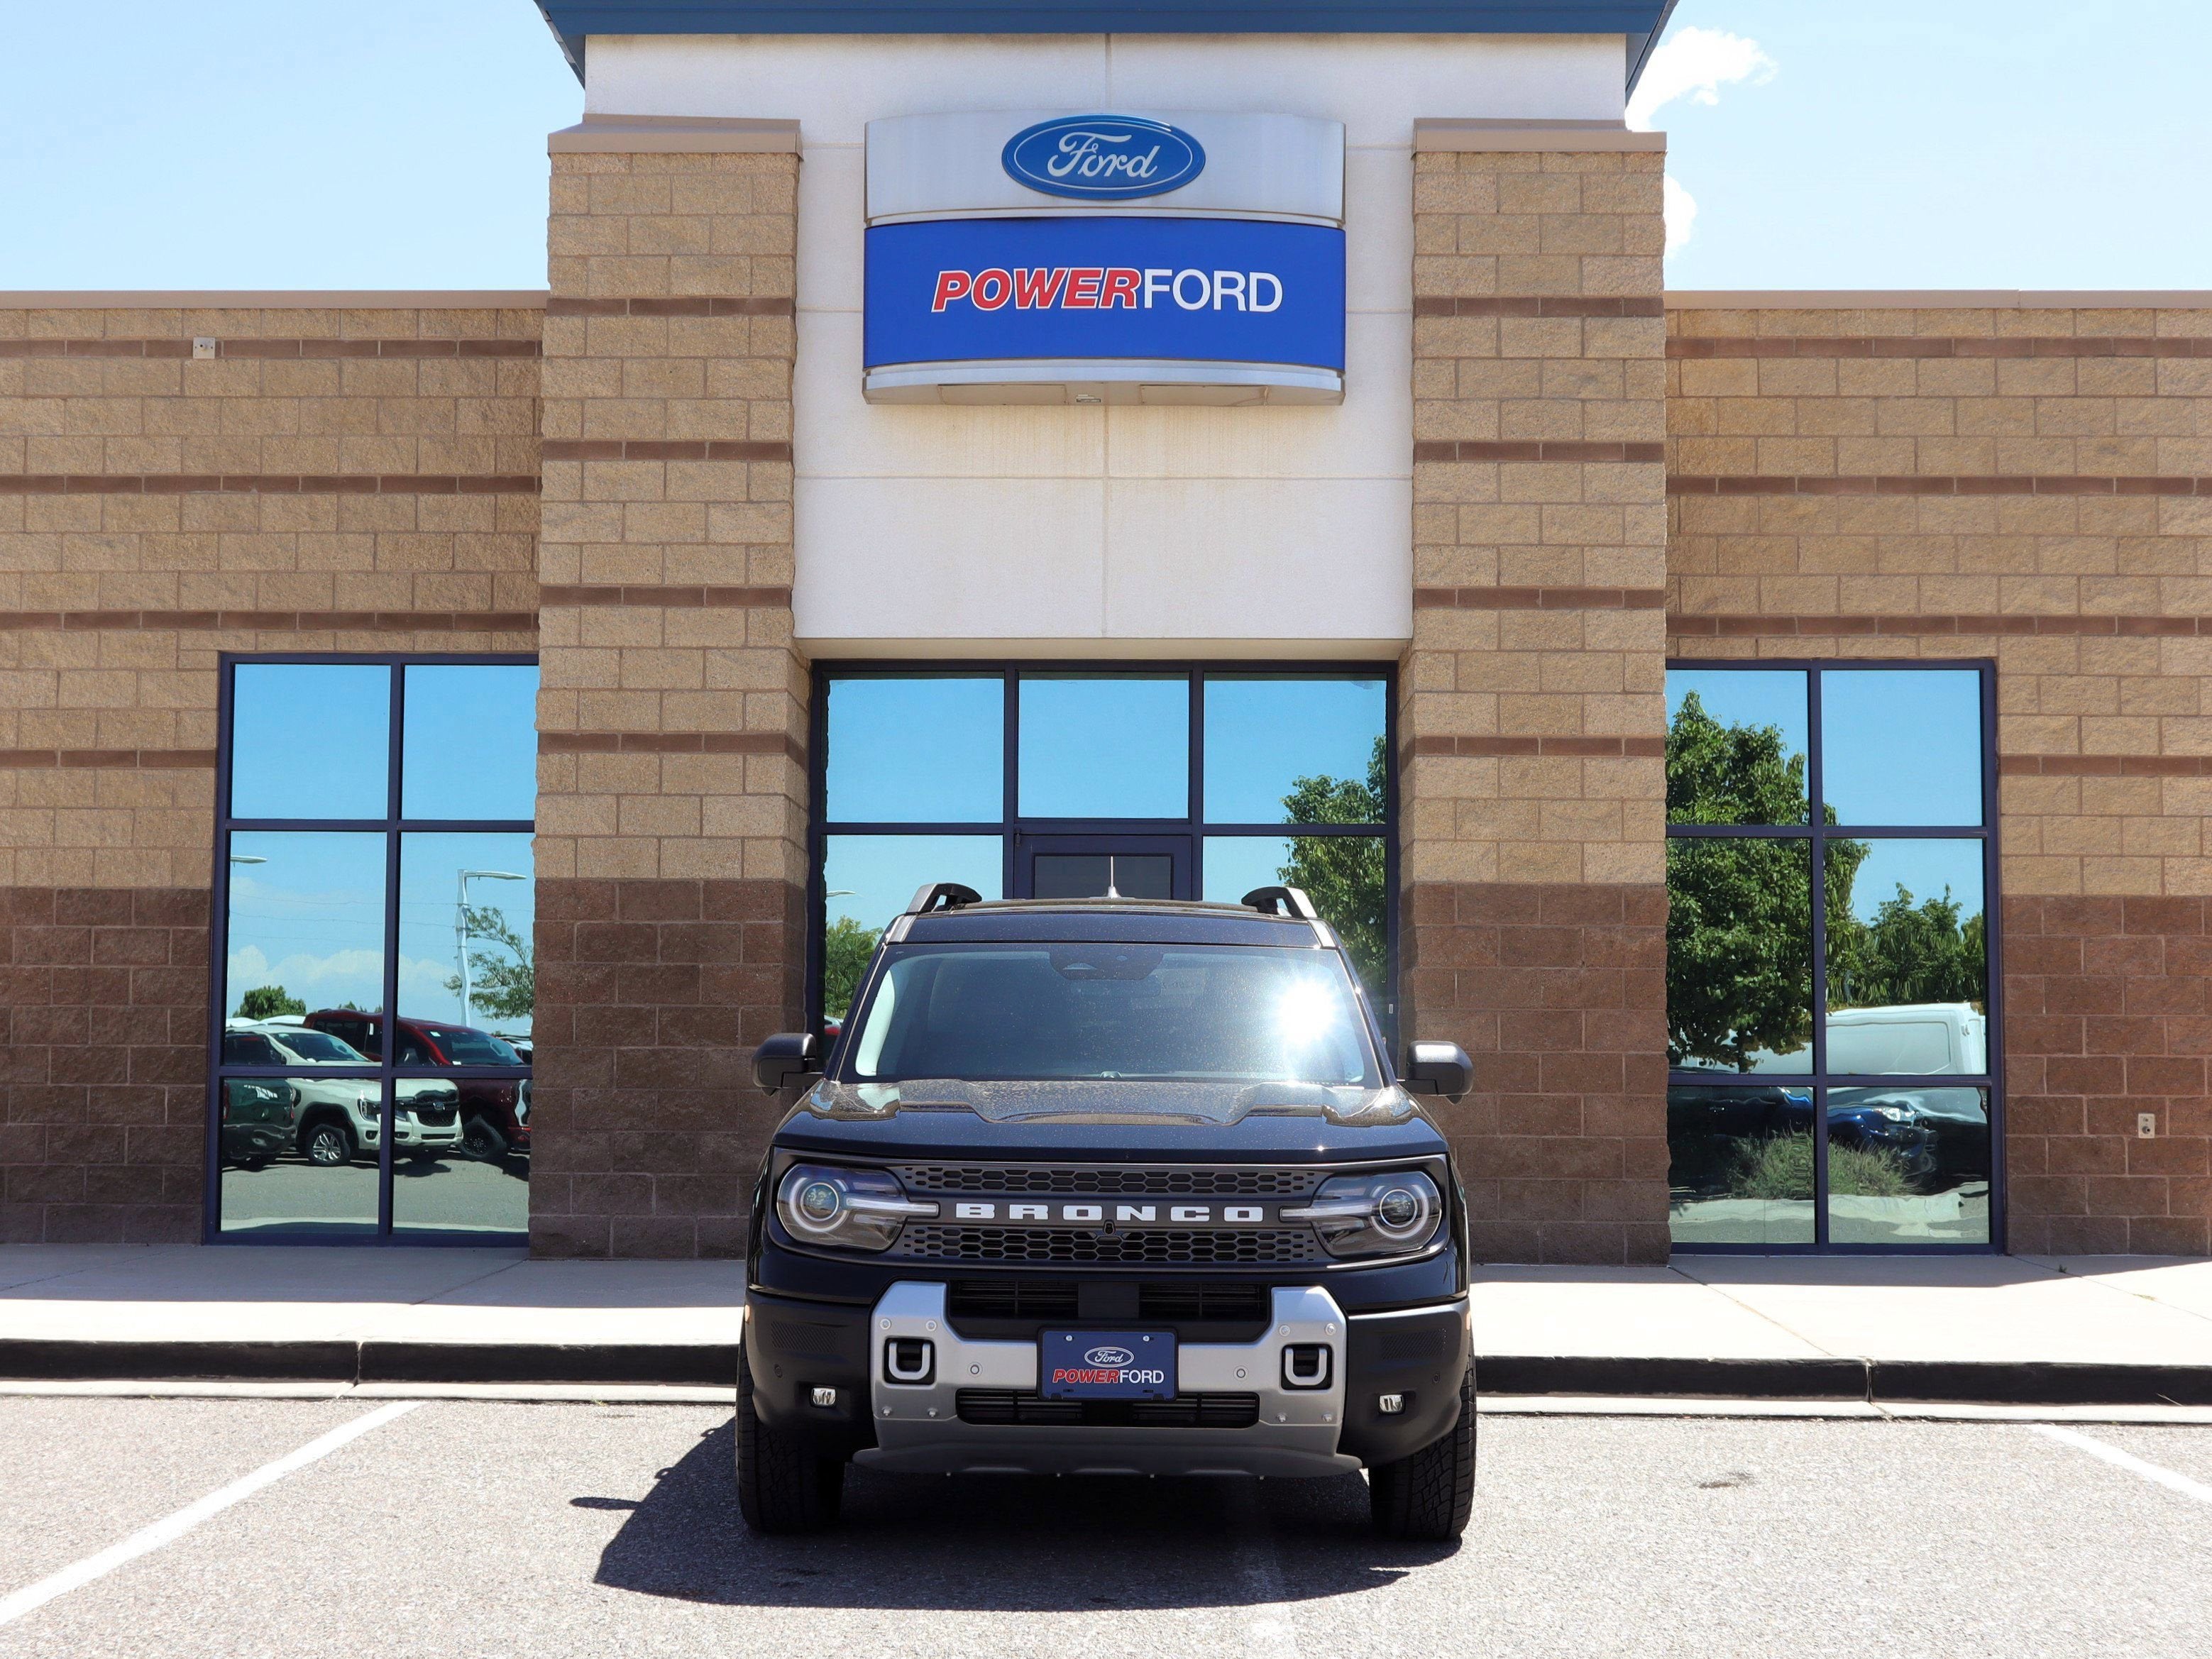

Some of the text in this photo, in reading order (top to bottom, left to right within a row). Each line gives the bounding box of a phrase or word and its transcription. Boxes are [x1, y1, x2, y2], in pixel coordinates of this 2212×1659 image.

[1047, 131, 1160, 177] Ford
[955, 1203, 1263, 1222] BRONCO
[1094, 1350, 1124, 1364] Ford
